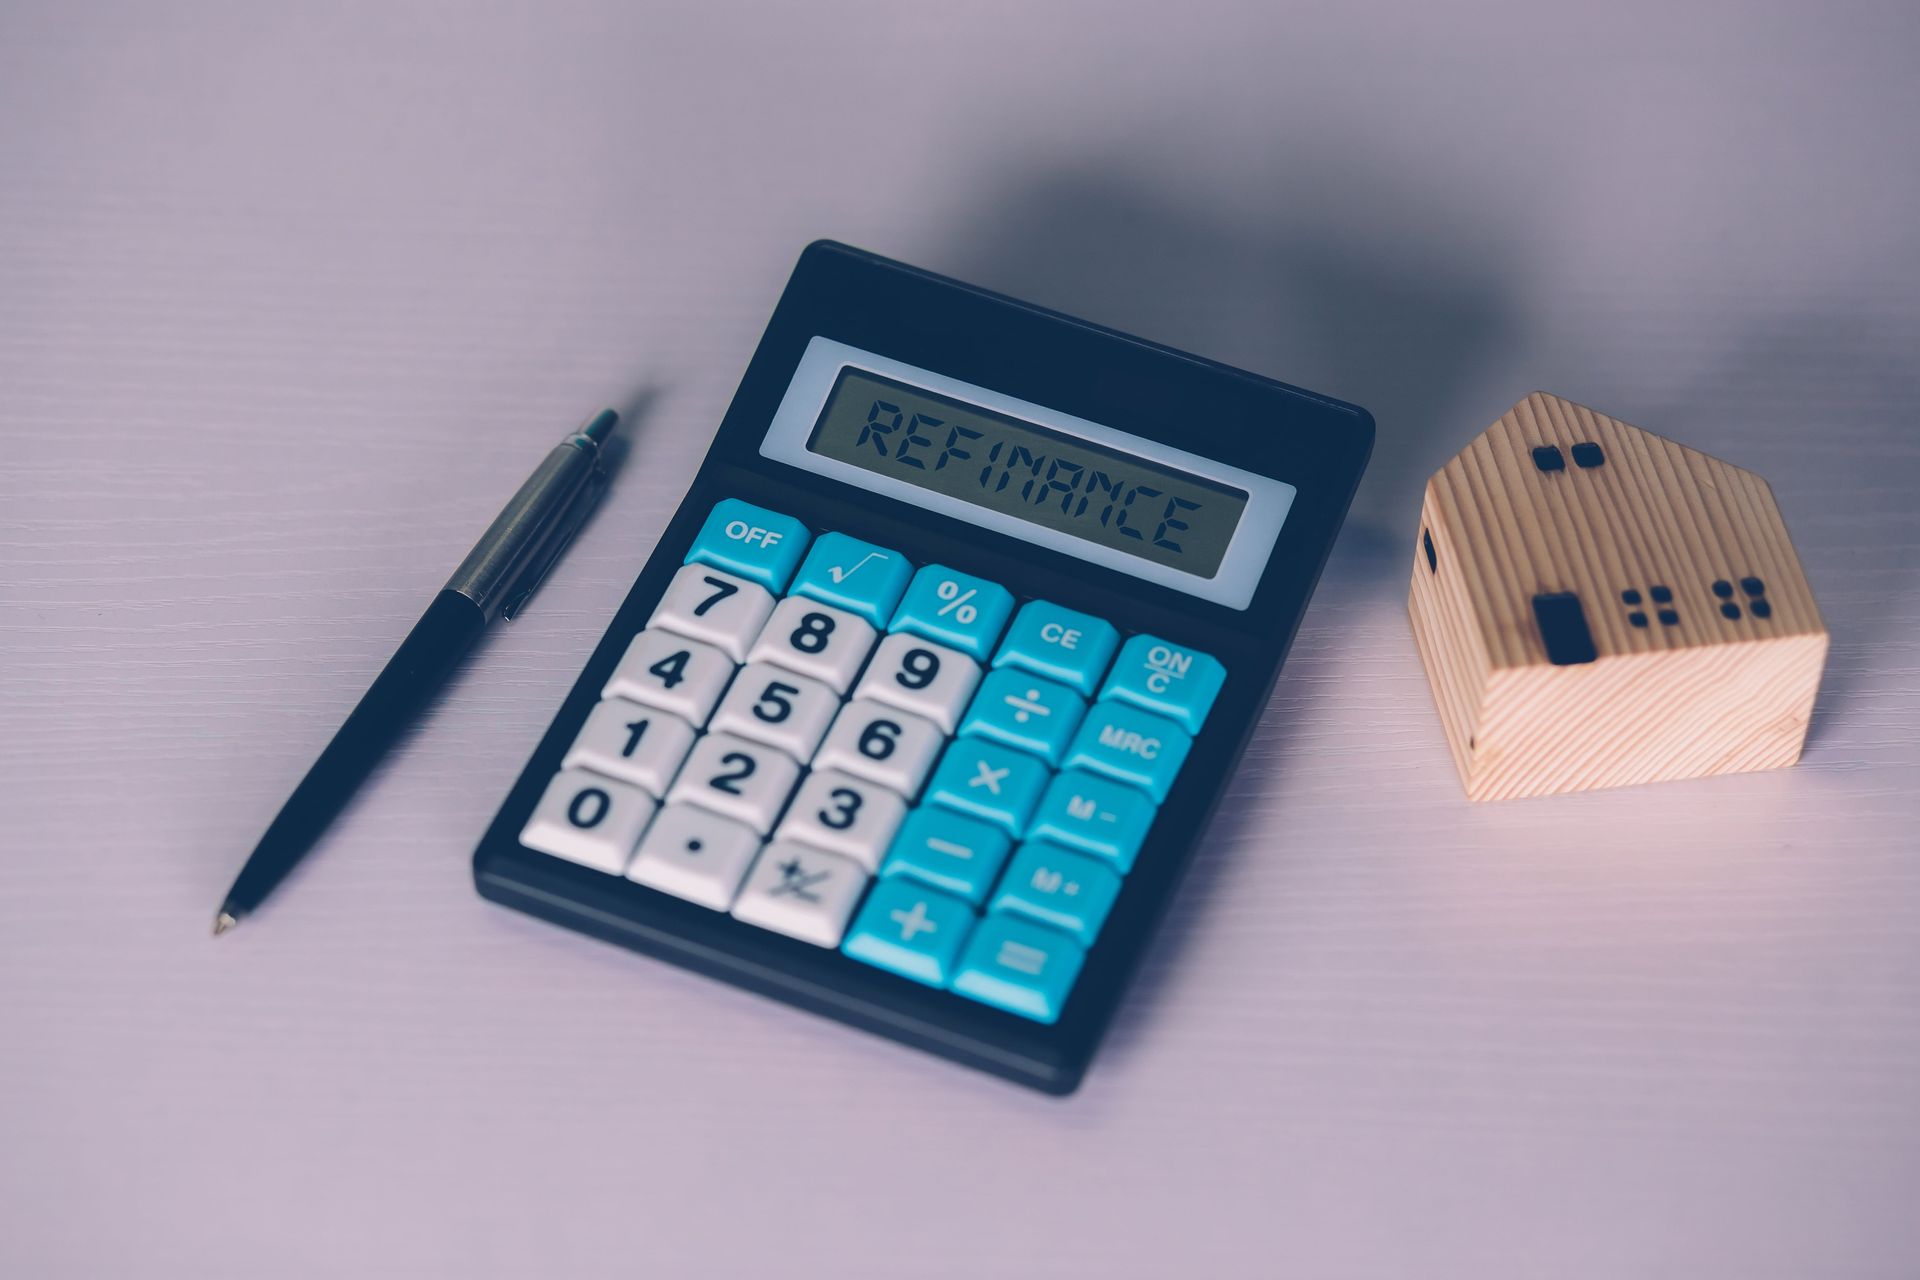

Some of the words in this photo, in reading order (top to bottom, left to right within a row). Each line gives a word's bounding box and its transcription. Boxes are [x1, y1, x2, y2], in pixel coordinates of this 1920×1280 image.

[856, 400, 1203, 554] REFINANCE
[724, 519, 783, 550] OFF
[693, 576, 739, 617] 7
[936, 580, 978, 625] %
[790, 612, 837, 655] 8
[1040, 622, 1081, 651] CE
[649, 650, 691, 688] 4
[895, 648, 941, 691] 9
[1147, 645, 1192, 672] ON
[753, 681, 800, 724] 5
[1146, 671, 1171, 694] C
[622, 719, 649, 758] 1
[857, 719, 903, 761] 6
[1100, 724, 1161, 761] MRC
[709, 752, 757, 795] 2
[567, 788, 611, 829] 0
[818, 788, 864, 830] 3
